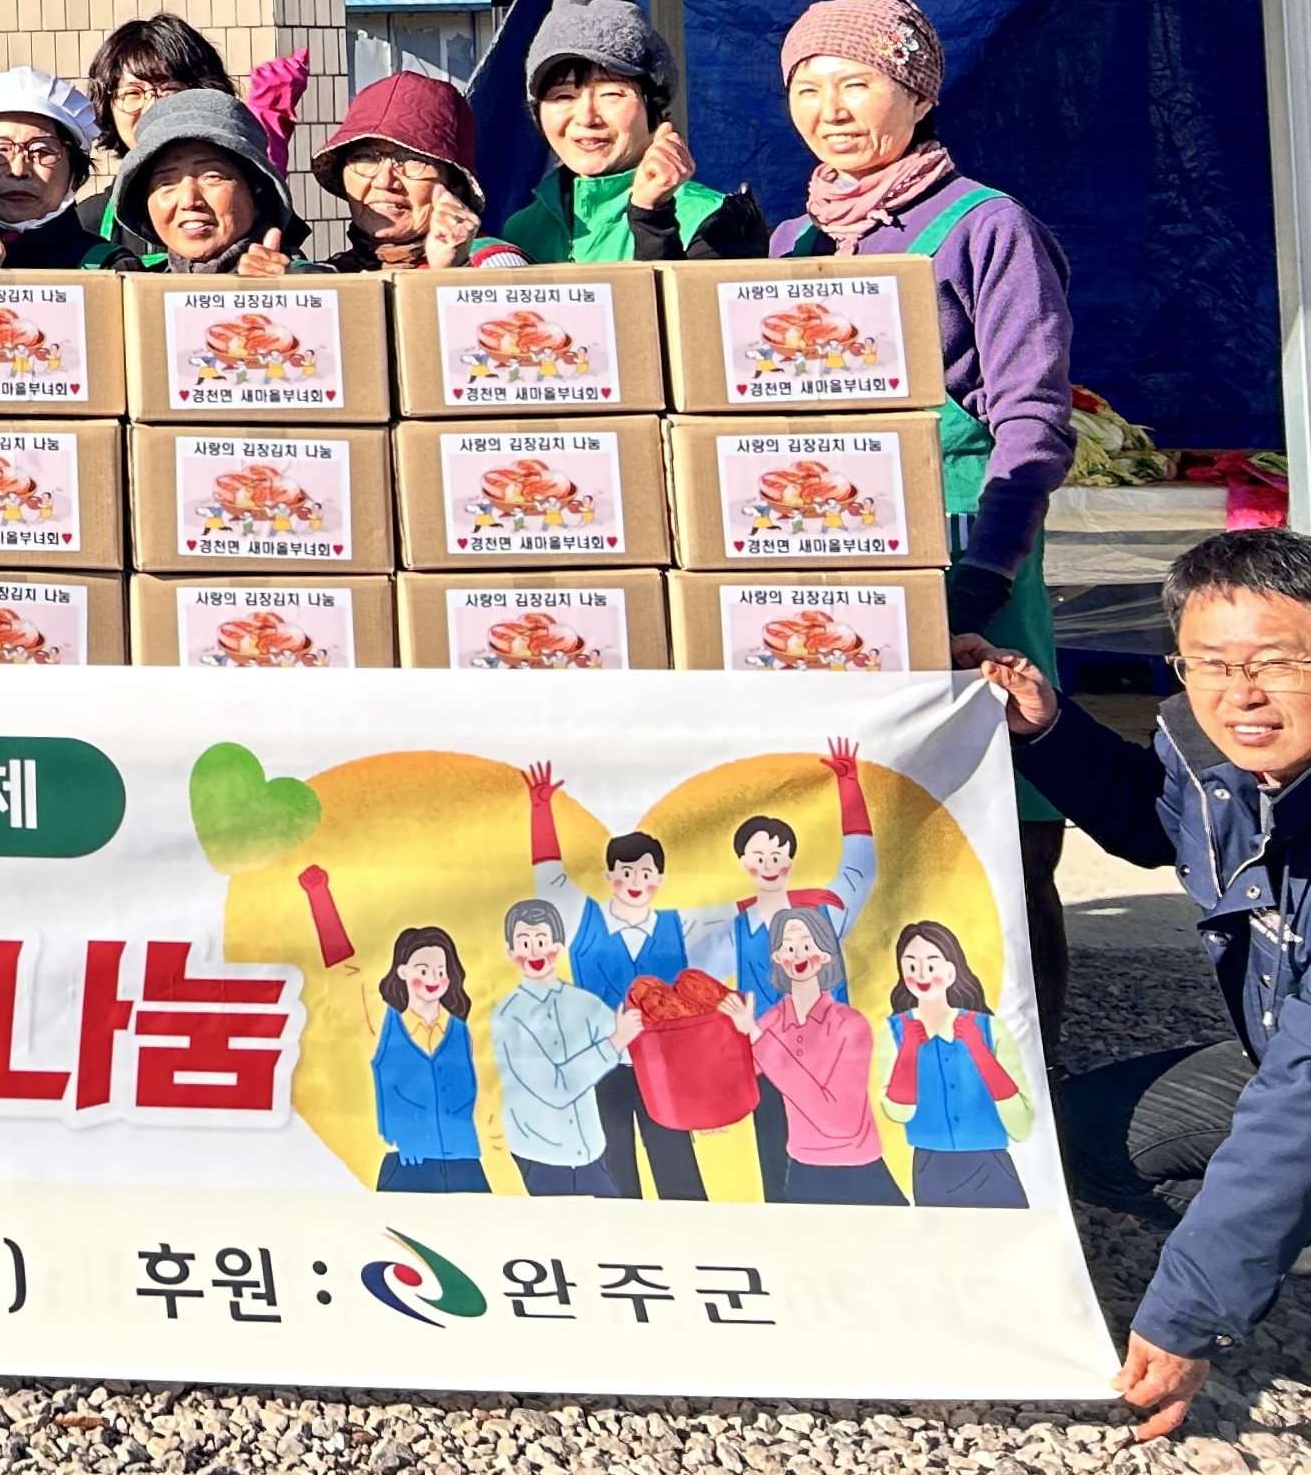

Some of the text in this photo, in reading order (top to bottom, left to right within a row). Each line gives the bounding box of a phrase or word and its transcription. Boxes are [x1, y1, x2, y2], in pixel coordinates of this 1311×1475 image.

[42, 290, 66, 302] 나눔
[458, 290, 594, 302] 사랑의 김장김치 나눔
[739, 283, 878, 299] 사랑의 김장김치 나눔
[186, 295, 321, 308] 사랑의 김장김치 나눔
[468, 387, 597, 401] 경천면 새마을부녀회
[752, 379, 885, 396] 경천면 새마을부녀회
[194, 389, 322, 403] 경천면 새마을부녀회
[34, 438, 58, 450] 나눔
[195, 443, 331, 459] 사랑의 김장김치 나눔
[461, 438, 599, 451] 사랑의 김장김치 나눔
[738, 437, 881, 452] 사랑의 김장김치 나눔
[202, 539, 329, 556] 경천면 새마을부녀회
[473, 536, 603, 551] 경천면 새마을부녀회
[750, 538, 884, 553] 경천면 새마을부녀회
[45, 589, 69, 603] 나눔
[198, 593, 334, 607] 사랑의 김장김치 나눔
[467, 593, 606, 607] 사랑의 김장김치 나눔
[741, 590, 885, 604] 사랑의 김장김치 나눔
